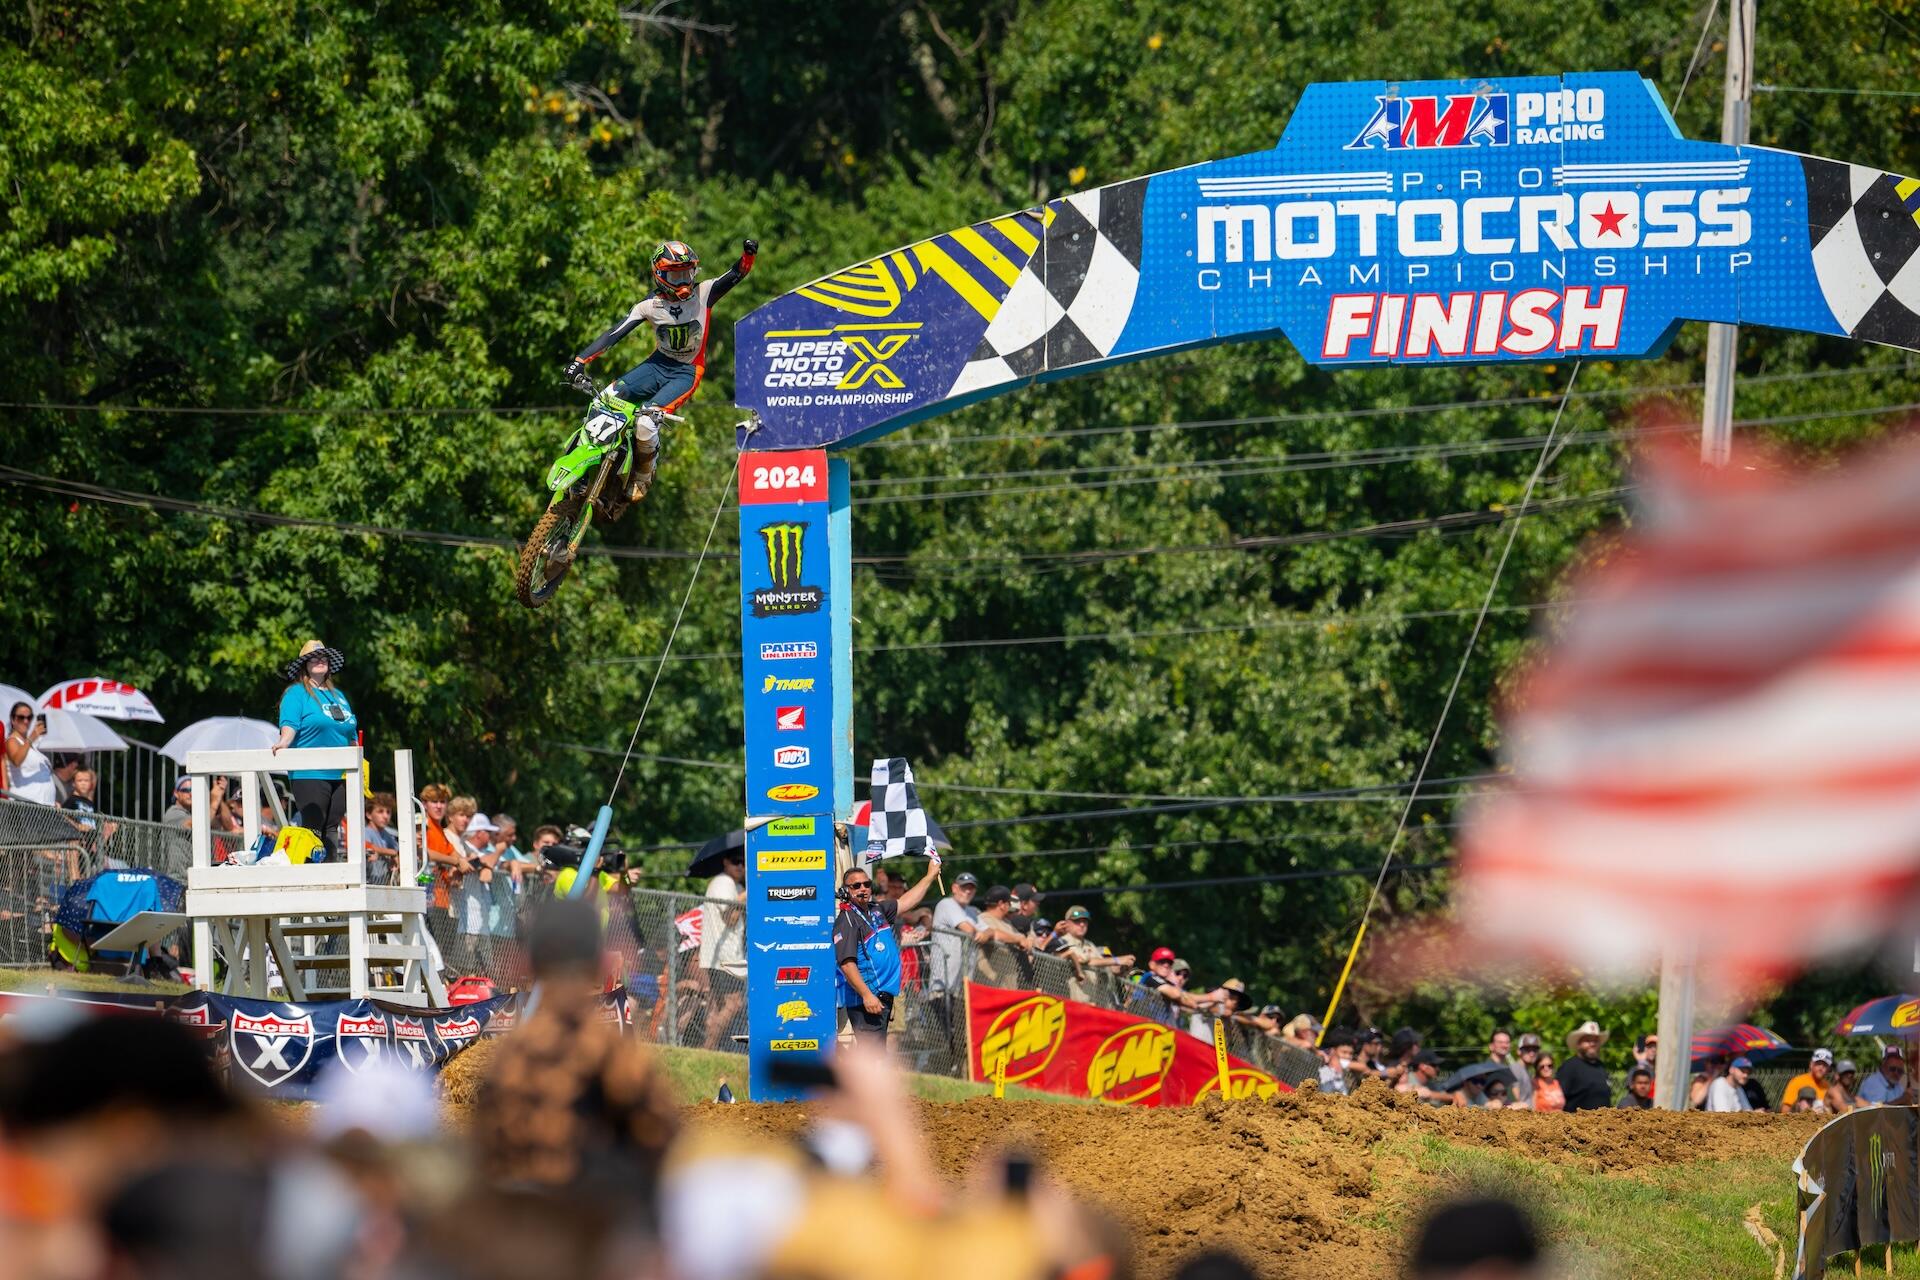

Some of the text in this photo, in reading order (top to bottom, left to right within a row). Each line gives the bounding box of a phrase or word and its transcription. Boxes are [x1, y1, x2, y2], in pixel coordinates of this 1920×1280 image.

[1516, 88, 1604, 126] PRO
[1343, 93, 1510, 150] AMA
[1516, 124, 1605, 145] RACING
[1402, 167, 1543, 192] PRO
[1197, 187, 1752, 264] MOTOCROSS
[1198, 252, 1752, 291] CHAMPIONSHIP
[1321, 285, 1628, 359] FINISH
[765, 341, 848, 358] SUPER
[769, 356, 844, 373] MOTO
[764, 371, 845, 388] CROSS
[767, 392, 914, 407] WORLD CHAMPIONSHIP
[584, 414, 624, 441] 47
[753, 465, 816, 490] 2024
[755, 591, 817, 605] MONSTER
[764, 603, 808, 611] ENERGY
[762, 643, 816, 653] PARTS
[762, 651, 816, 659] UNLIMITED
[776, 678, 815, 690] THOR
[779, 750, 806, 764] 100%
[773, 823, 810, 831] Kawasaki
[768, 888, 806, 899] TRIUMPH
[238, 1020, 307, 1034] RACER
[396, 1026, 424, 1036] RACER
[438, 1023, 478, 1036] RACER
[772, 1041, 817, 1050] ACERBIS
[983, 999, 1065, 1078] FMF
[250, 1034, 291, 1071] X
[1090, 1030, 1176, 1099] FMF
